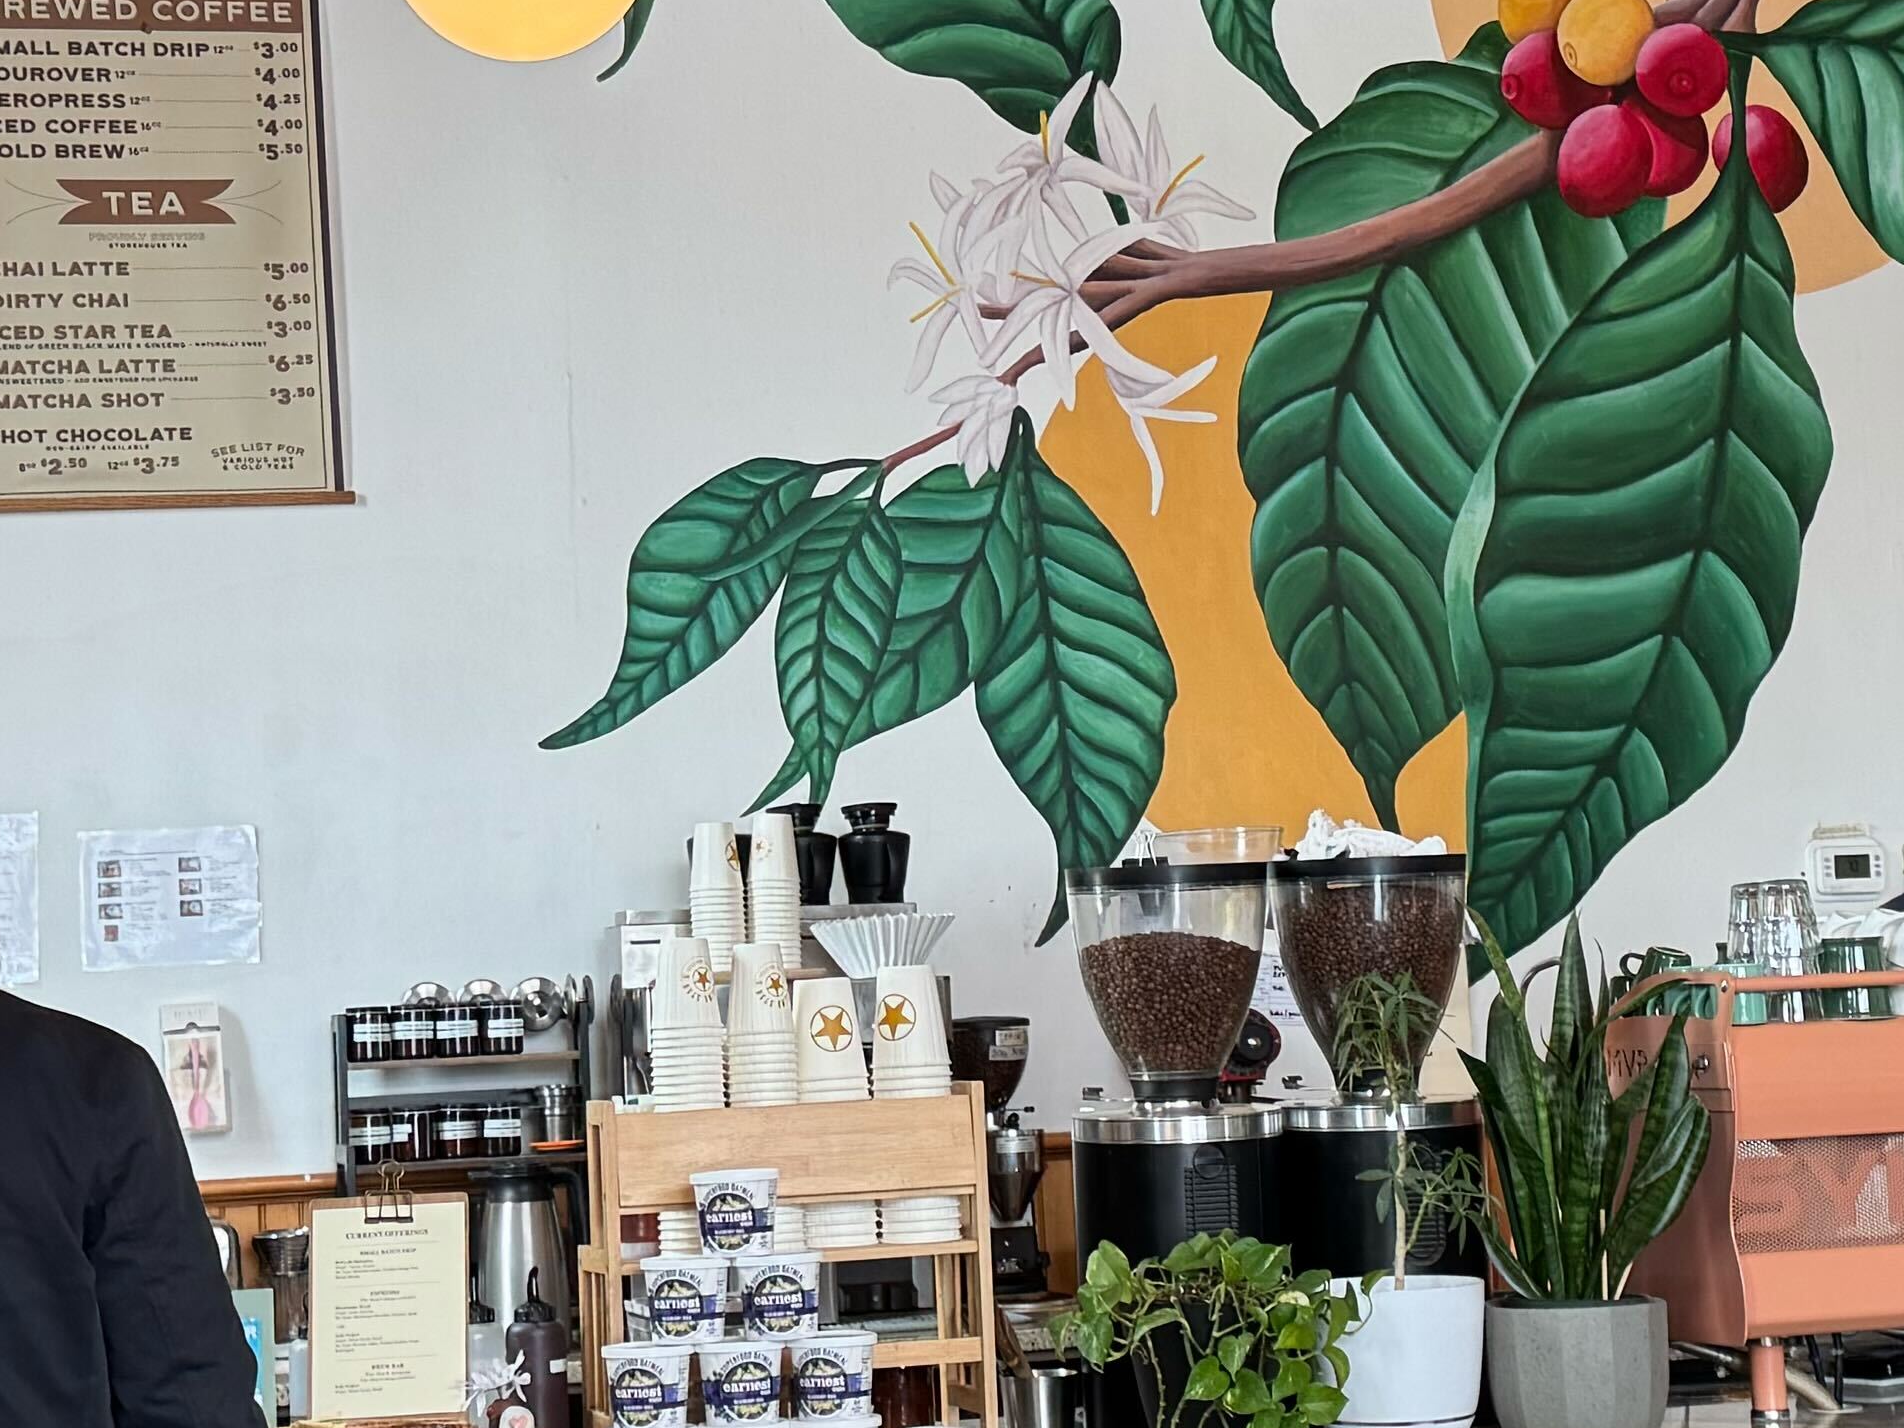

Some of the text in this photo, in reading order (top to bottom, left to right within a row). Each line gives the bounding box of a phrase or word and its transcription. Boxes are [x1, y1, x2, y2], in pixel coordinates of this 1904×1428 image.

[152, 0, 294, 23] COFFEE
[68, 41, 146, 57] BATCH
[154, 42, 209, 57] DRIP
[253, 42, 298, 59] $3.00
[254, 68, 301, 85] $4.00
[256, 93, 301, 110] $4.25
[45, 119, 138, 134] COFFEE
[257, 119, 303, 136] $4.00
[55, 144, 125, 159] BREW
[259, 144, 304, 160] $5.50
[102, 191, 186, 217] TEA
[51, 261, 130, 277] LATTE
[263, 262, 309, 281] $5.00
[72, 293, 129, 309] CHAI
[265, 293, 311, 312] $6.50
[54, 325, 118, 340] STAR
[124, 324, 173, 339] TEA
[266, 320, 312, 339] $3.00
[98, 358, 176, 374] LATTE
[268, 354, 314, 373] $6.25
[101, 392, 164, 408] SHOT
[269, 387, 315, 405] $3.50
[0, 427, 193, 444] HOT CHOCOLATE
[210, 442, 306, 459] SEE LIST FOR
[41, 456, 180, 476] $2.50 $3.75
[1607, 1049, 1647, 1078] MVP
[706, 1209, 753, 1224] earnest
[346, 1228, 428, 1240] CURRENT OFFERINGS
[654, 1297, 701, 1310] earnest
[754, 1292, 803, 1307] earnest
[723, 1380, 772, 1394] earnest
[799, 1375, 846, 1388] earnest
[615, 1384, 662, 1399] earnest
